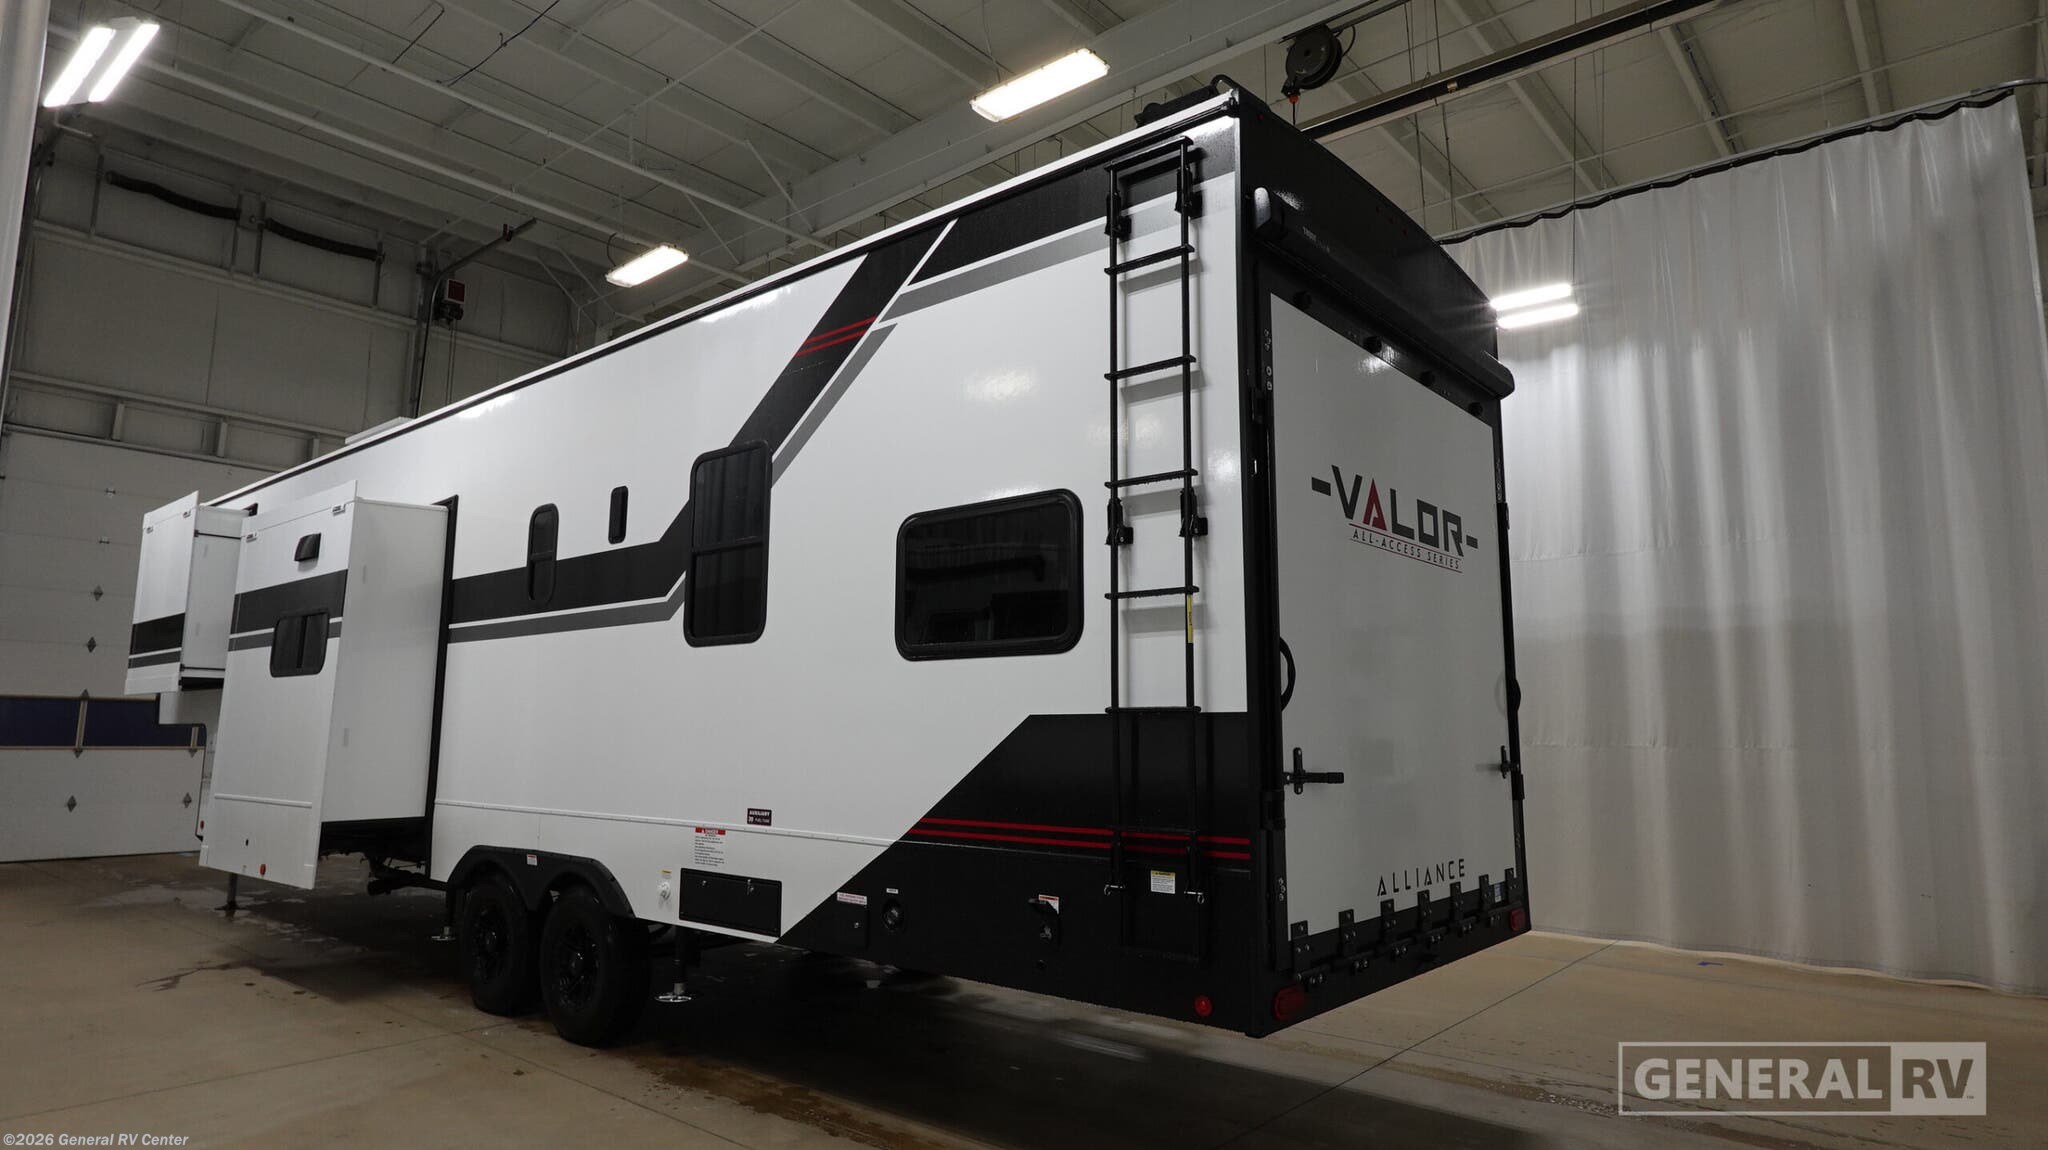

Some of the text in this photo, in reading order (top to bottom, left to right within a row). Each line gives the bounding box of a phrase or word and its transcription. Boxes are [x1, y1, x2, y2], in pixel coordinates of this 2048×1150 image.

[1353, 529, 1460, 570] ALL-ACCESS SERIES
[1377, 858, 1465, 896] ALLIANCE
